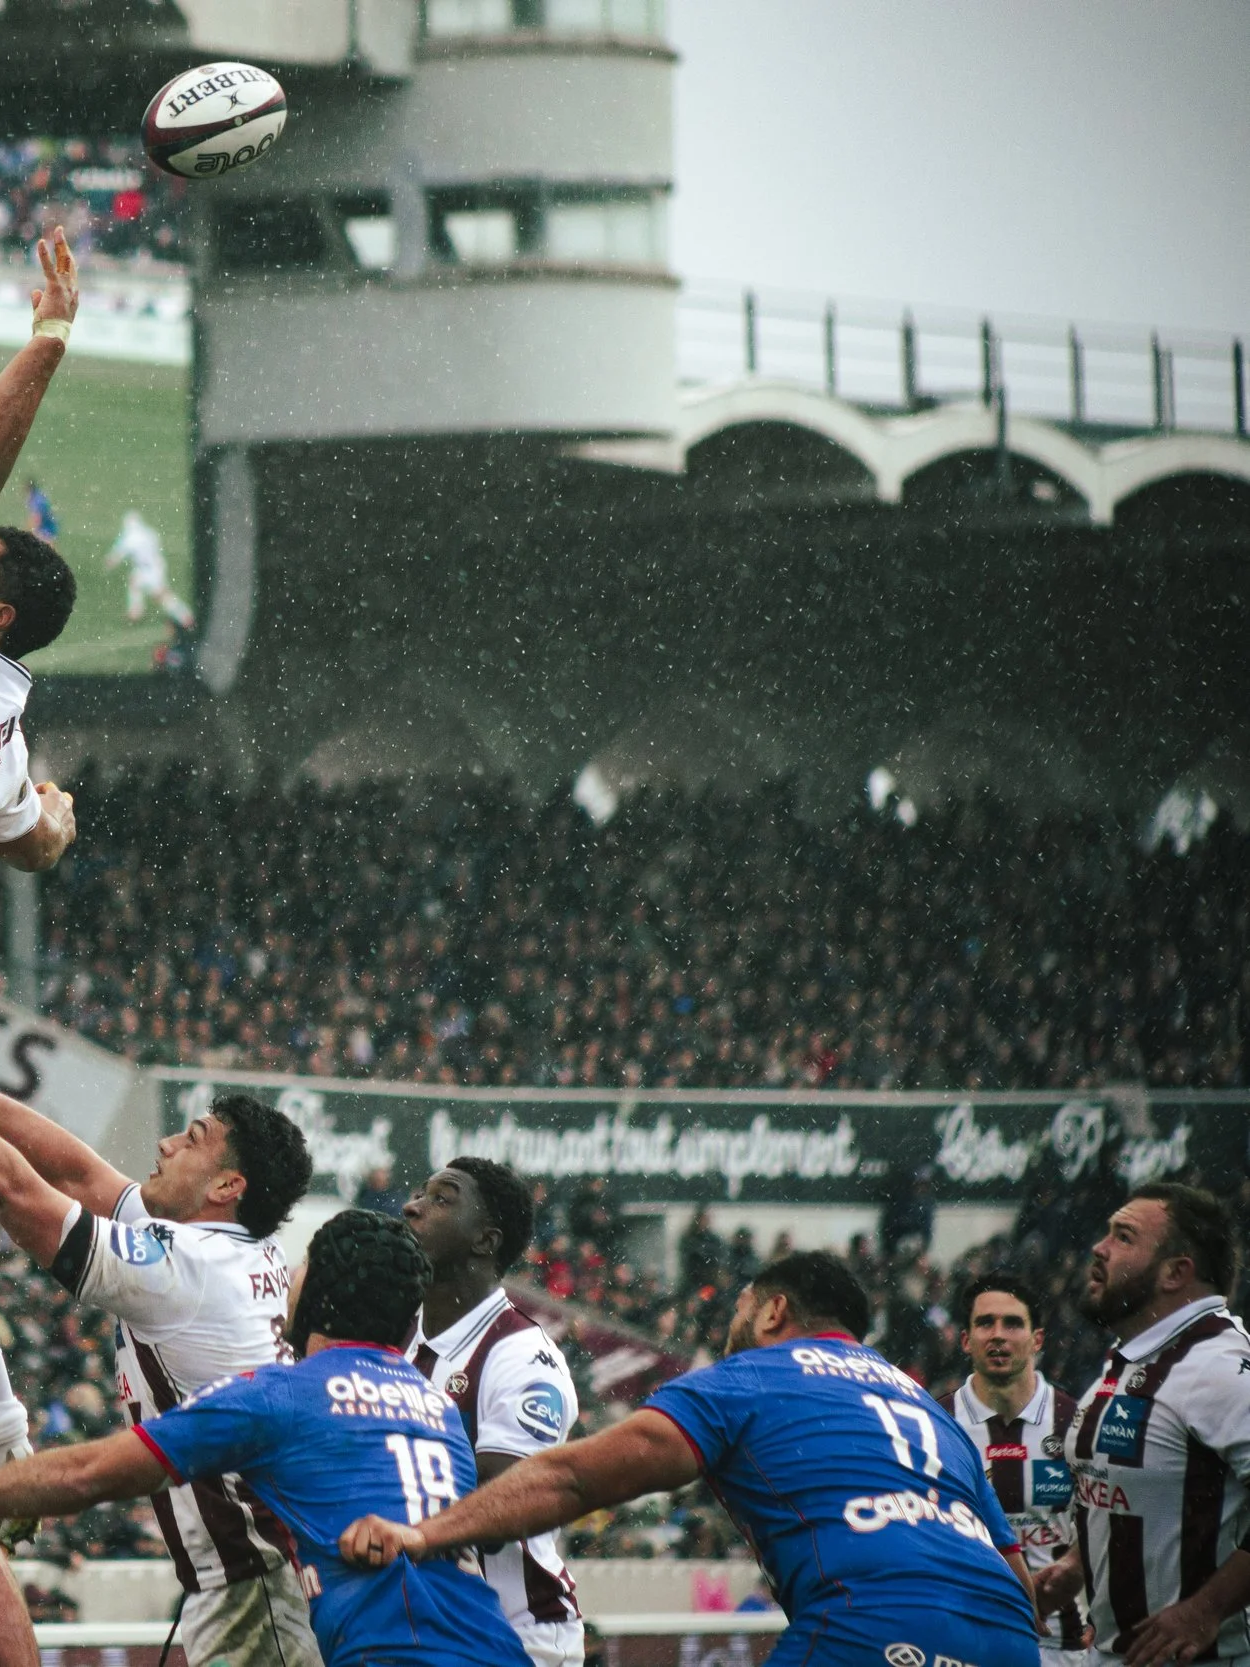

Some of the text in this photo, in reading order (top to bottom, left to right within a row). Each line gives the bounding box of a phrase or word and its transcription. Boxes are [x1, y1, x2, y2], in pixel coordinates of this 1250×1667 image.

[862, 1393, 944, 1480] 17
[844, 1488, 995, 1549] Capri-Su
[1077, 1479, 1131, 1511] KEA
